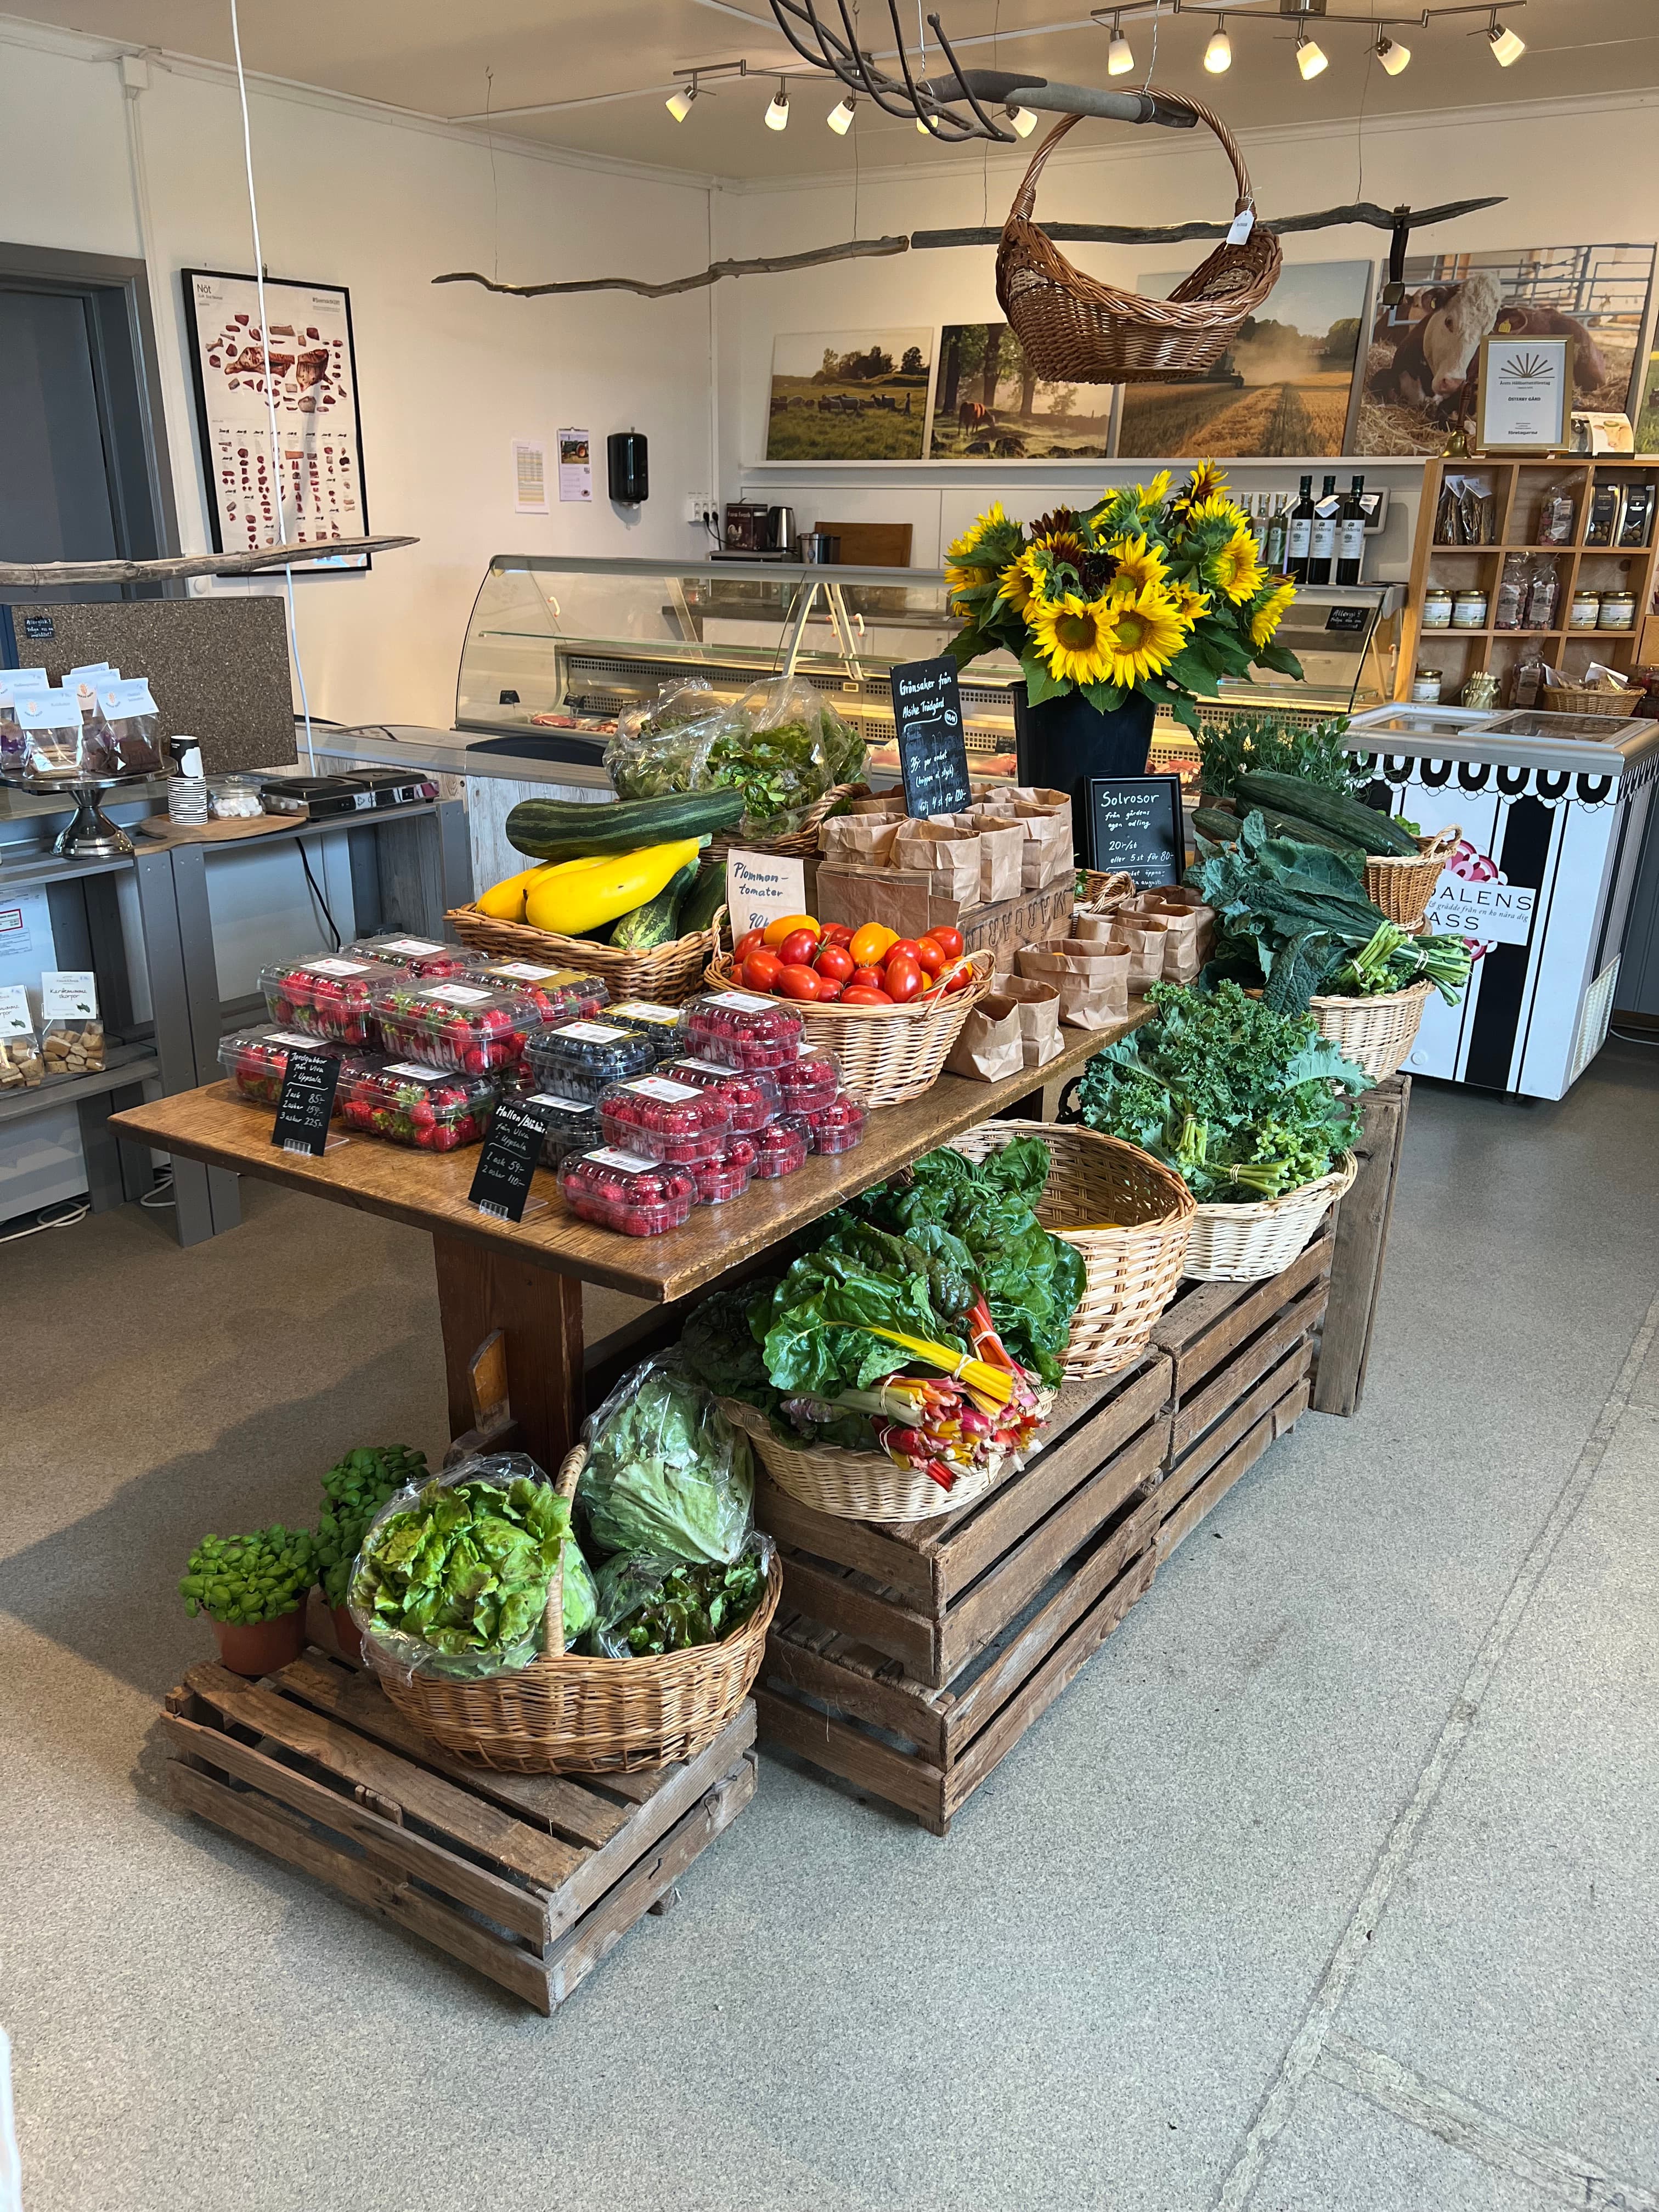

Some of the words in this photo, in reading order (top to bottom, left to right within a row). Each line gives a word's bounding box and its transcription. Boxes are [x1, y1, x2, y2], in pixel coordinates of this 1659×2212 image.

[198, 284, 211, 294] Nöt
[900, 678, 935, 696] Grönsaker
[939, 672, 952, 690] från
[902, 703, 921, 719] Alsike
[921, 697, 944, 715] Trädgård
[1101, 791, 1159, 807] Solrosor
[1105, 811, 1120, 821] från
[1125, 809, 1150, 820] gårdens
[1108, 823, 1122, 831] egen
[1128, 820, 1151, 829] odling
[1147, 853, 1158, 862] för
[734, 862, 789, 883] Plommon-
[739, 883, 783, 897] tomater
[1141, 879, 1162, 888] augusti
[749, 913, 770, 929] 90k
[1430, 911, 1480, 931] ASS
[1460, 906, 1477, 914] från
[1489, 909, 1497, 917] ko
[1517, 913, 1529, 922] dig
[965, 890, 1066, 955] MARGARIN
[298, 1073, 321, 1084] Uppsala
[514, 1128, 529, 1139] Ulva
[501, 1135, 527, 1151] Uppsala
